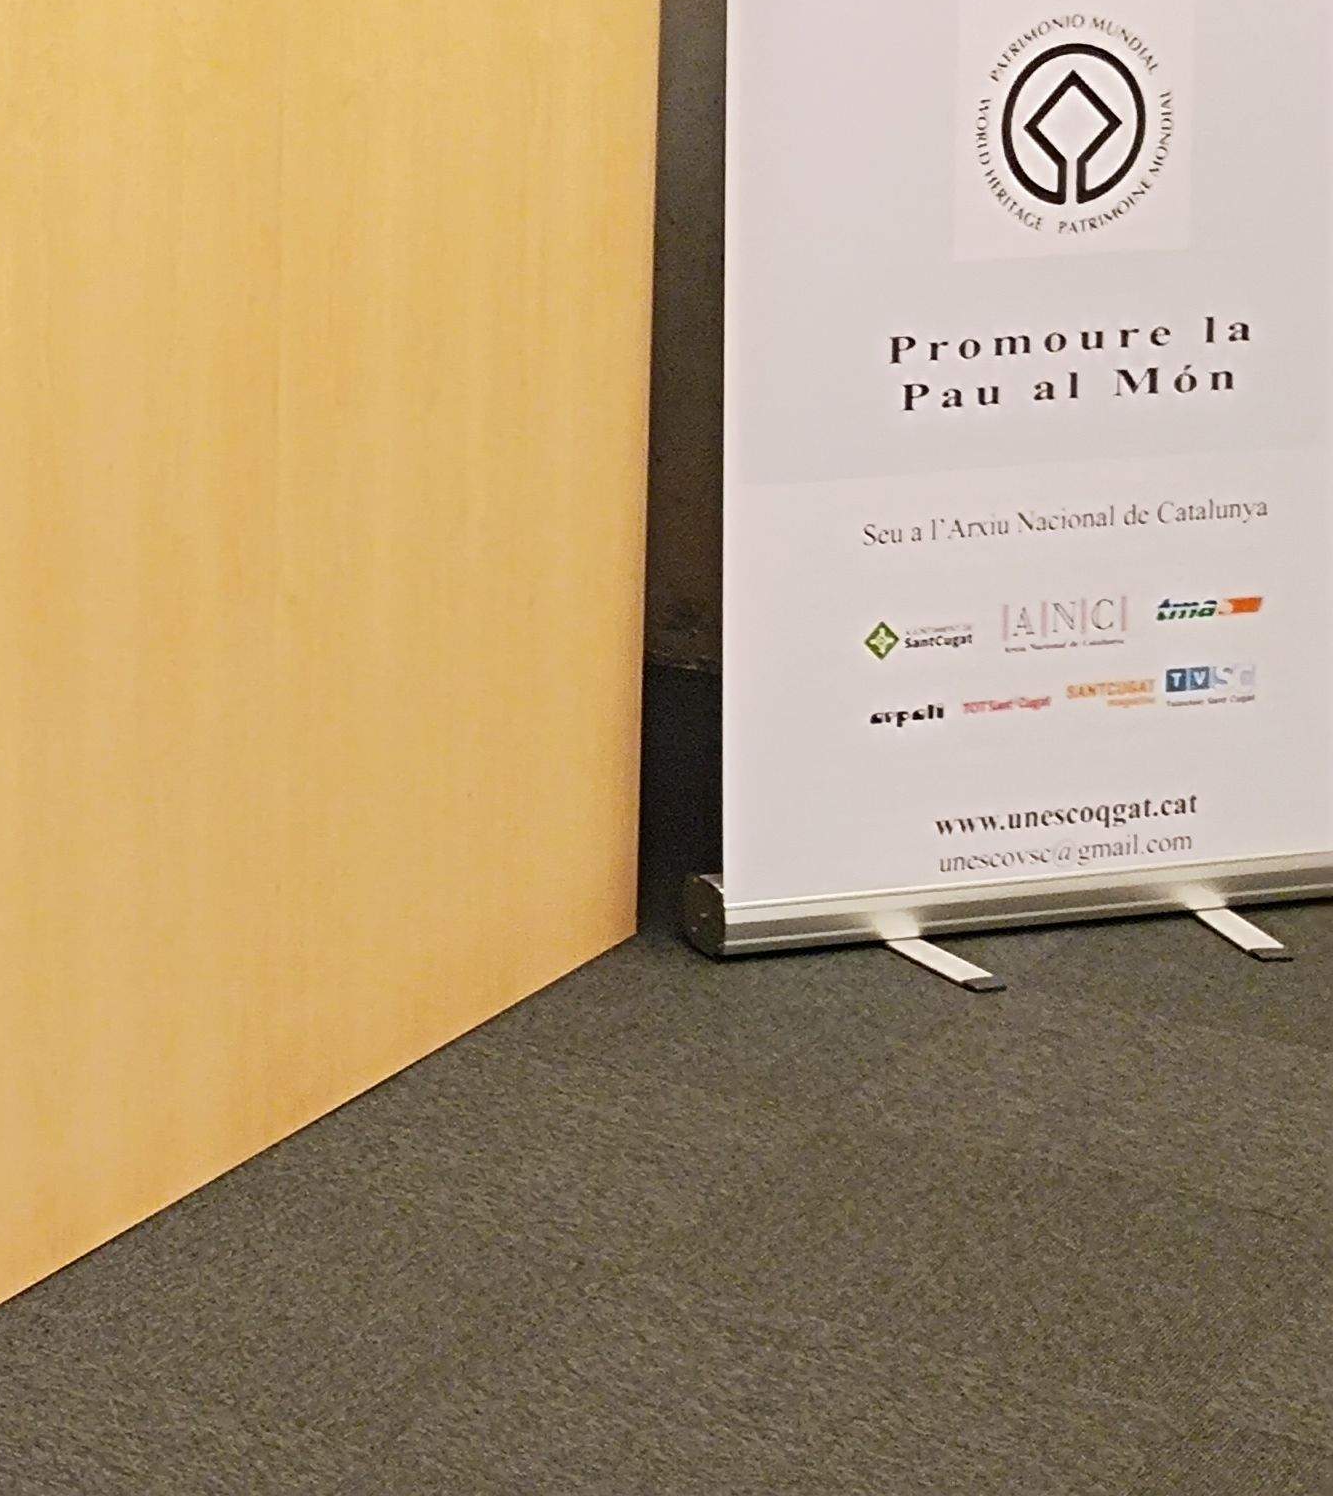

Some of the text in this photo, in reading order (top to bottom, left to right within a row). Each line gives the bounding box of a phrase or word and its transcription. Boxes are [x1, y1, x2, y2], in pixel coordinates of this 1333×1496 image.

[989, 13, 1160, 83] PATRIMONIO MUNDIAL
[983, 168, 1044, 232] HERITAGE
[1056, 178, 1153, 235] PATRIMOINE
[888, 316, 1252, 365] Promoure la
[901, 364, 1235, 412] Pau al Món
[862, 523, 904, 547] Seu
[910, 525, 923, 543] a
[1017, 505, 1115, 534] Nacional
[1123, 504, 1150, 526] de
[1157, 497, 1269, 526] Catalunya
[934, 794, 1198, 836] www.unescoqgat.cat
